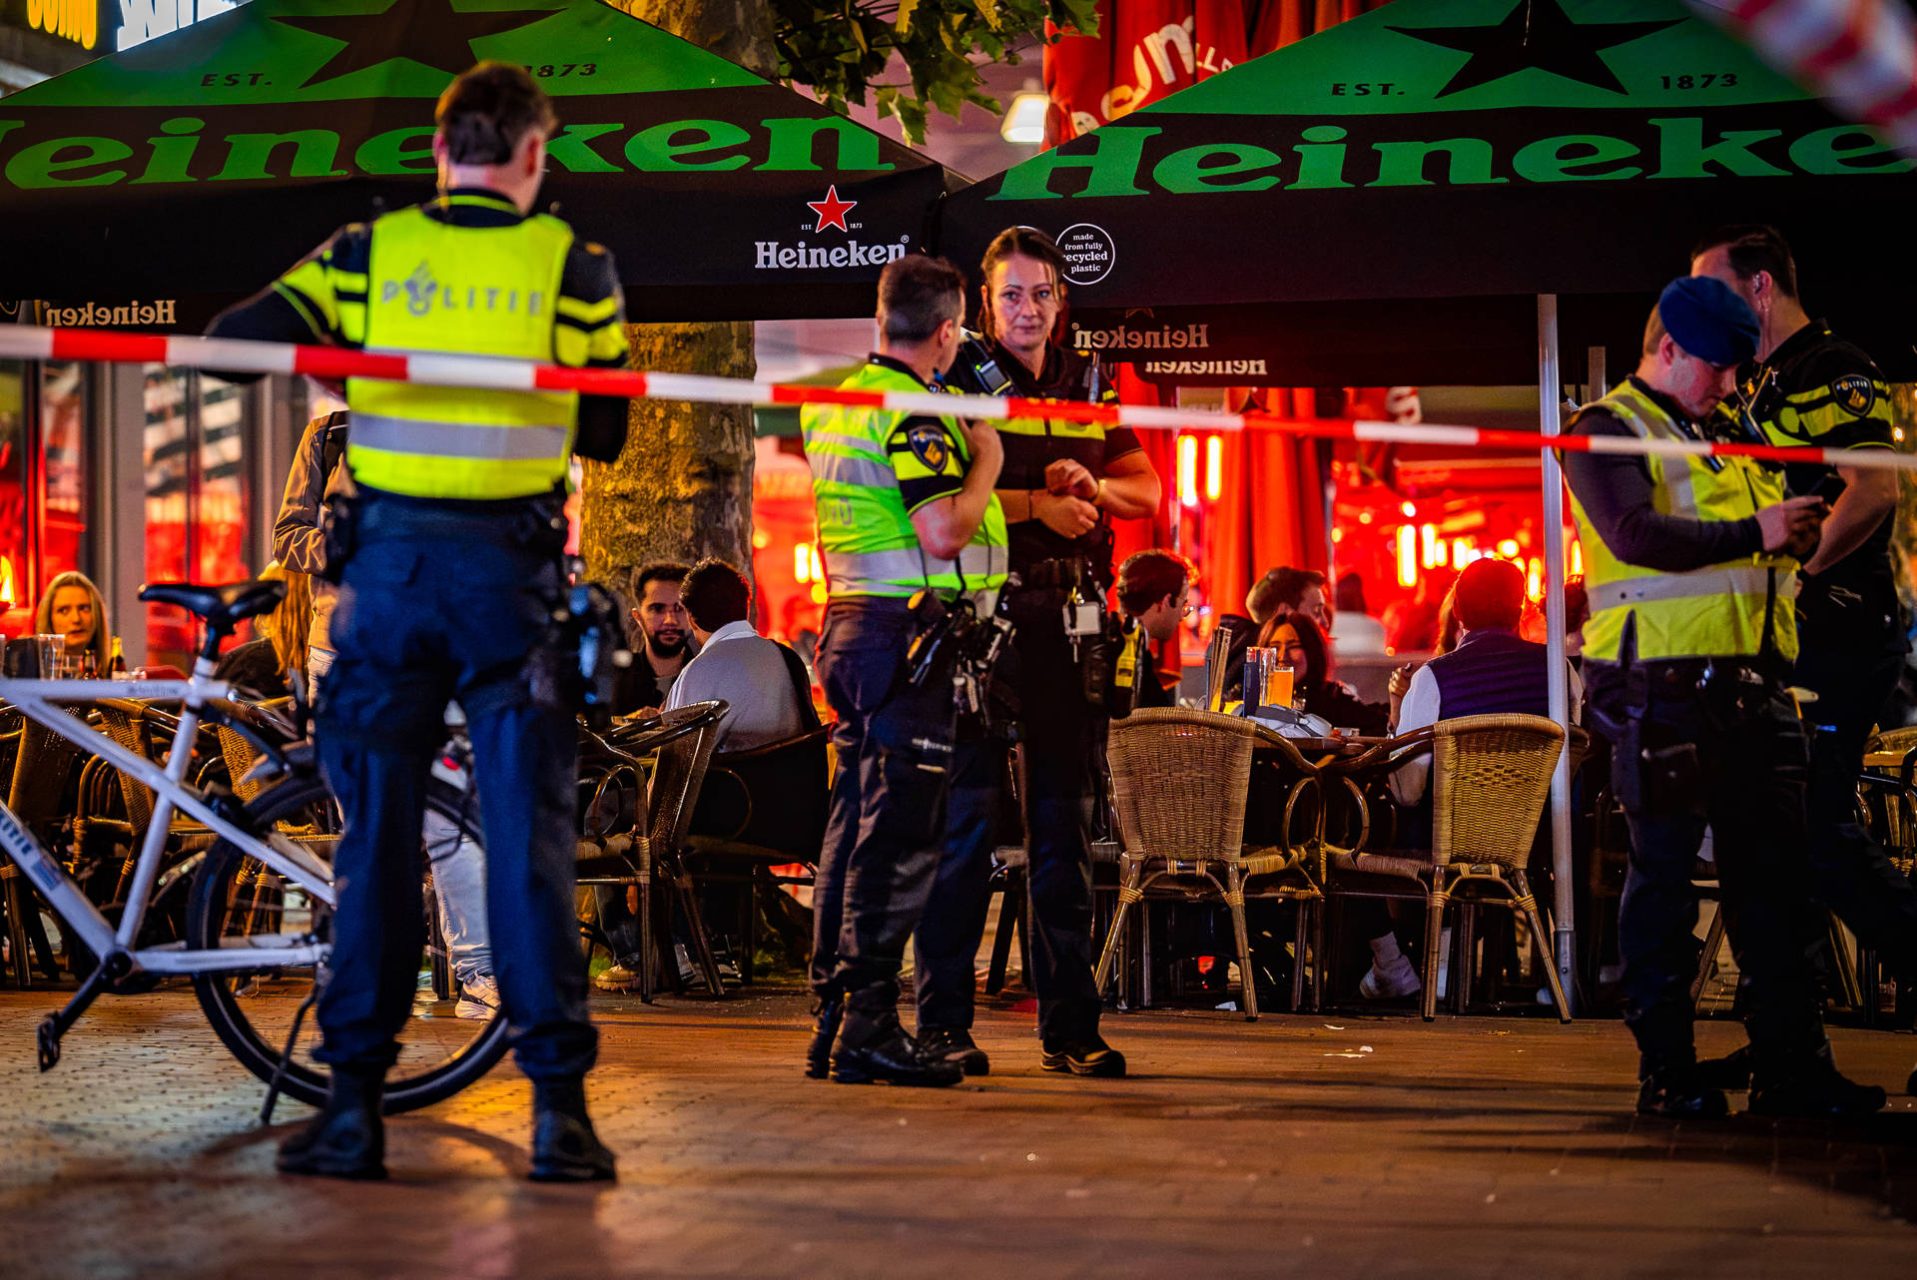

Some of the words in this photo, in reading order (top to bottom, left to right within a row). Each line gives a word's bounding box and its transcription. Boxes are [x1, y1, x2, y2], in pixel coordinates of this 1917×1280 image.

[201, 73, 272, 87] EST.
[1332, 83, 1405, 95] EST.
[1661, 73, 1738, 89] 1873
[0, 117, 896, 190] eineen
[1073, 233, 1094, 241] made
[1065, 243, 1084, 251] from
[1085, 242, 1103, 251] fully
[755, 240, 906, 269] Heineken
[1071, 264, 1101, 274] plastic
